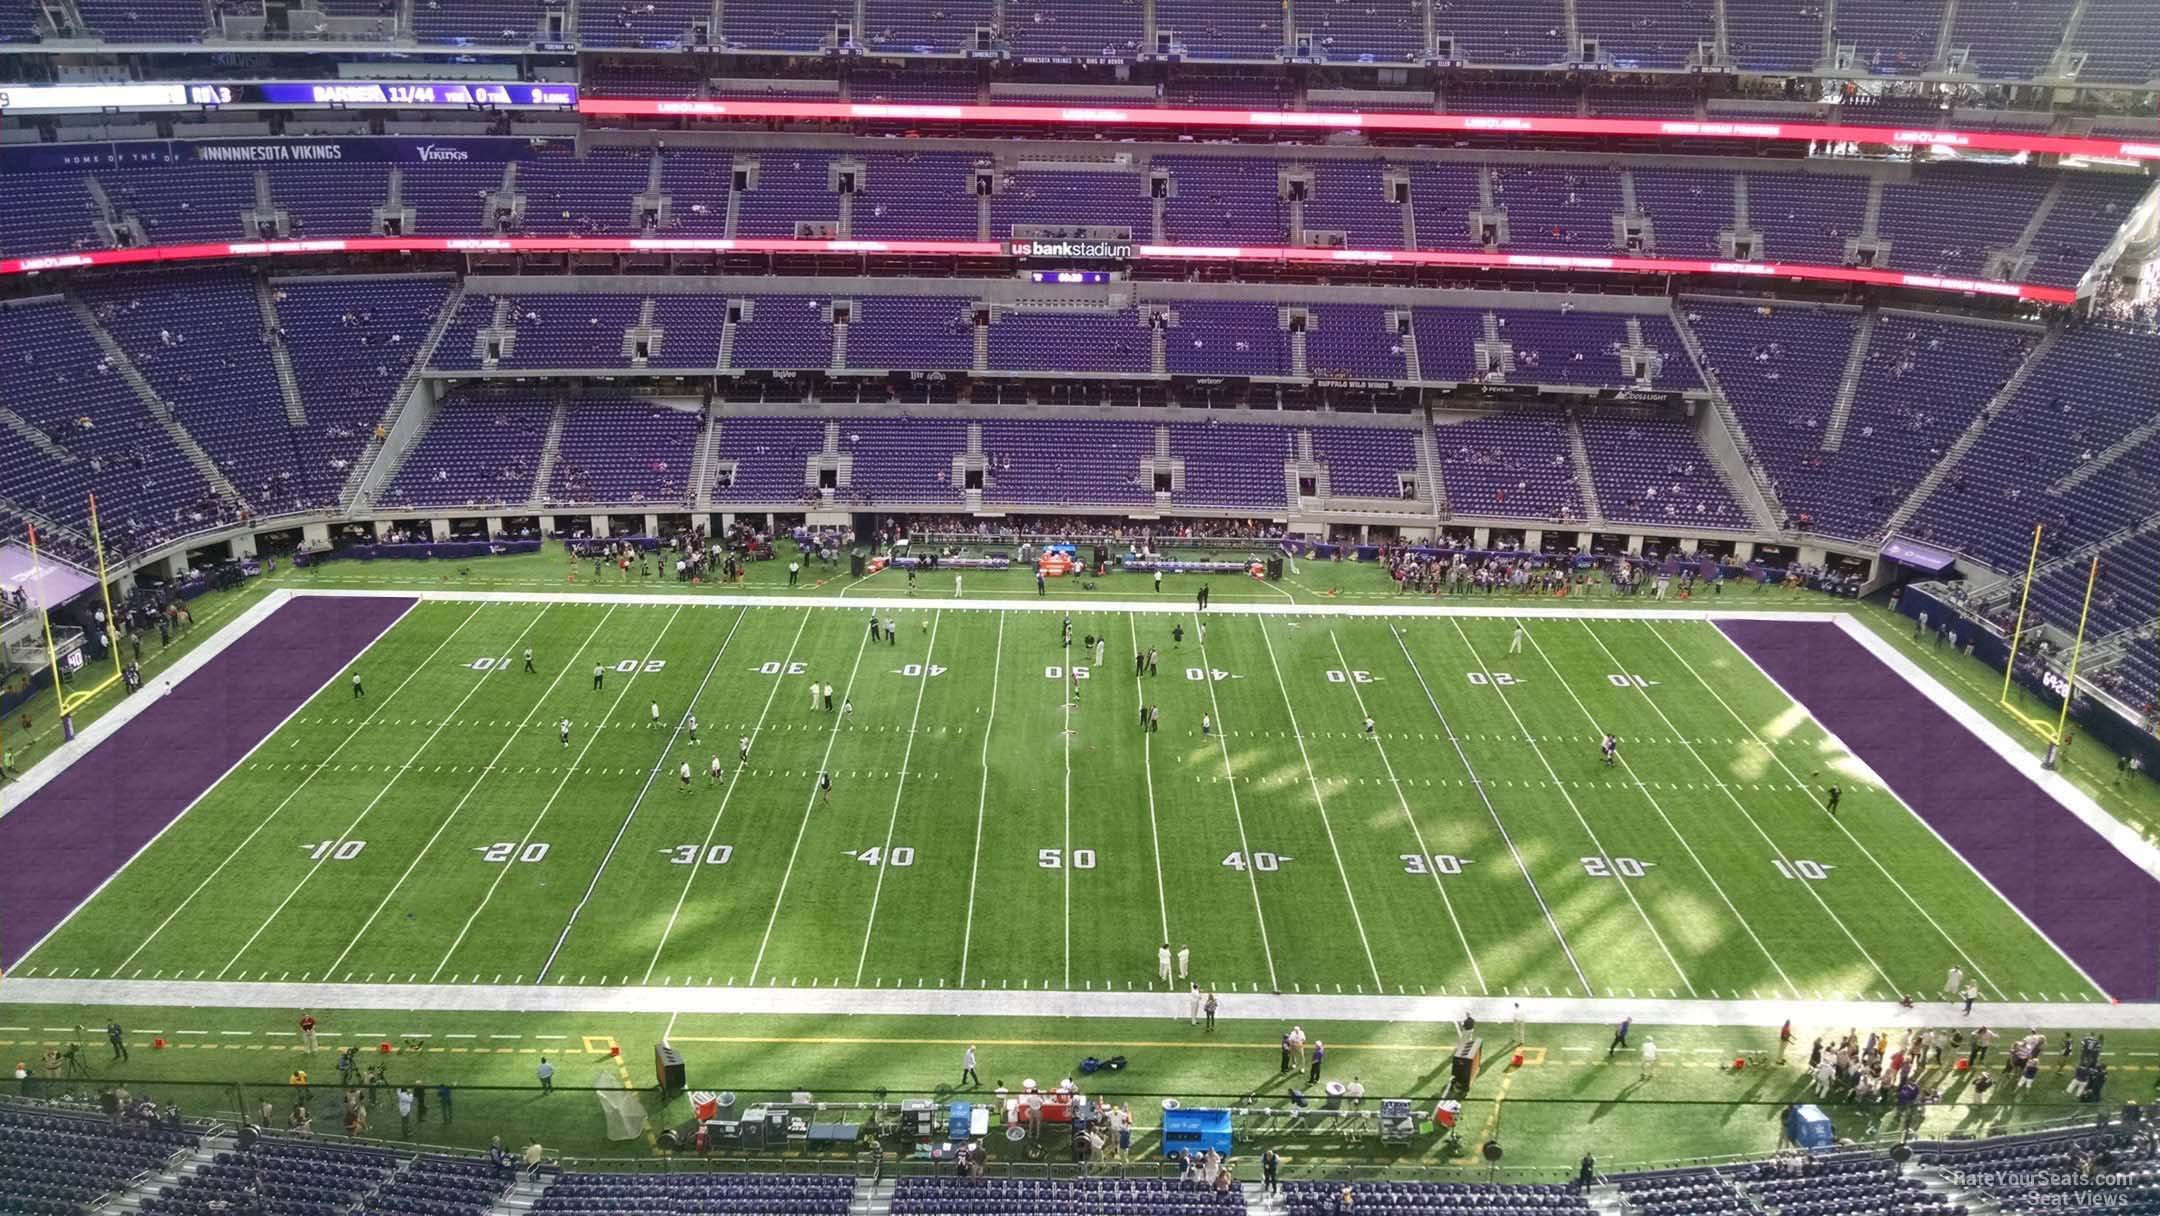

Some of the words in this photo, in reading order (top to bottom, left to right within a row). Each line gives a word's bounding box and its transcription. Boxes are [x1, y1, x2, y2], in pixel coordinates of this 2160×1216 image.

[64, 155, 99, 164] HOME
[132, 152, 156, 161] THE
[291, 145, 342, 159] VIKINGS
[310, 840, 367, 860] 10
[483, 842, 551, 862] 20
[670, 845, 734, 865] 30
[857, 846, 915, 866] 40
[1038, 849, 1097, 869] 50
[1222, 851, 1280, 871] 40
[1399, 854, 1463, 874] 30
[1580, 857, 1646, 877] 20
[1770, 860, 1828, 879] 10
